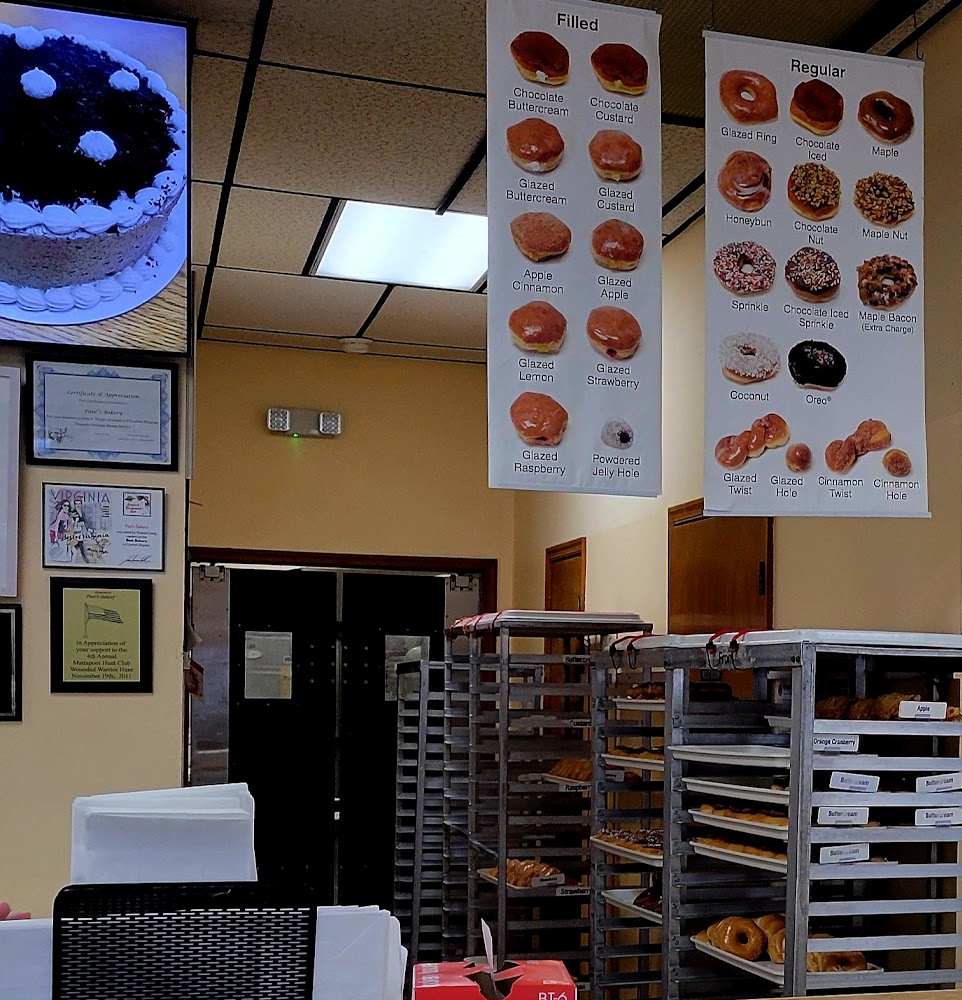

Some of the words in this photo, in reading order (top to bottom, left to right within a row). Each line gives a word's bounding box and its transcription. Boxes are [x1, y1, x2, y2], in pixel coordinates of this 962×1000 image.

[556, 12, 599, 32] Filled
[790, 58, 846, 78] Regular
[513, 87, 564, 103] Chocolate
[508, 100, 569, 117] Buttercream
[590, 97, 639, 113] Chocolate
[595, 110, 634, 124] Custard
[721, 126, 753, 140] Glazed
[756, 131, 777, 144] Ring
[795, 136, 840, 151] Chocolate
[808, 150, 827, 161] Iced
[871, 146, 899, 158] Maple
[519, 179, 555, 191] Glazed
[506, 190, 567, 205] Buttercream
[598, 187, 633, 200] Glazed
[597, 200, 635, 213] Custard
[726, 213, 772, 228] Honeybun
[794, 221, 838, 234] Chocolate
[808, 234, 824, 246] Nut
[862, 228, 890, 240] Maple
[892, 230, 908, 241] Nut
[523, 269, 553, 282] Apple
[597, 275, 632, 288] Glazed
[512, 281, 564, 294] Cinnamon
[600, 288, 629, 301] Apple
[731, 300, 769, 313] Sprinkle
[783, 305, 828, 318] Chocolate
[830, 308, 849, 319] Iced
[799, 317, 834, 330] Sprinkle
[858, 311, 886, 323] Maple
[888, 313, 917, 323] Bacon
[861, 323, 883, 333] (Extra
[885, 325, 914, 335] Charge)
[518, 358, 555, 370] Glazed
[596, 363, 631, 375] Glazed
[519, 371, 554, 382] Lemon
[587, 376, 640, 390] Strawberry
[730, 390, 769, 402] Coconut
[522, 450, 558, 461] Glazed
[592, 454, 641, 466] Powdered
[514, 463, 566, 476] Raspberry
[592, 467, 615, 479] Jelly
[617, 468, 640, 478] Hole
[723, 472, 757, 483] Glazed
[770, 475, 804, 486] Glazed
[818, 477, 864, 487] Cinnamon
[873, 479, 920, 489] Cinnamon
[50, 489, 110, 503] VIRGINIA
[728, 485, 752, 495] Twist
[776, 488, 798, 498] Hole
[829, 489, 853, 498] Twist
[886, 491, 908, 501] Hole
[916, 705, 931, 713] Apple
[813, 737, 831, 746] Orange
[831, 738, 856, 747] Cranberry
